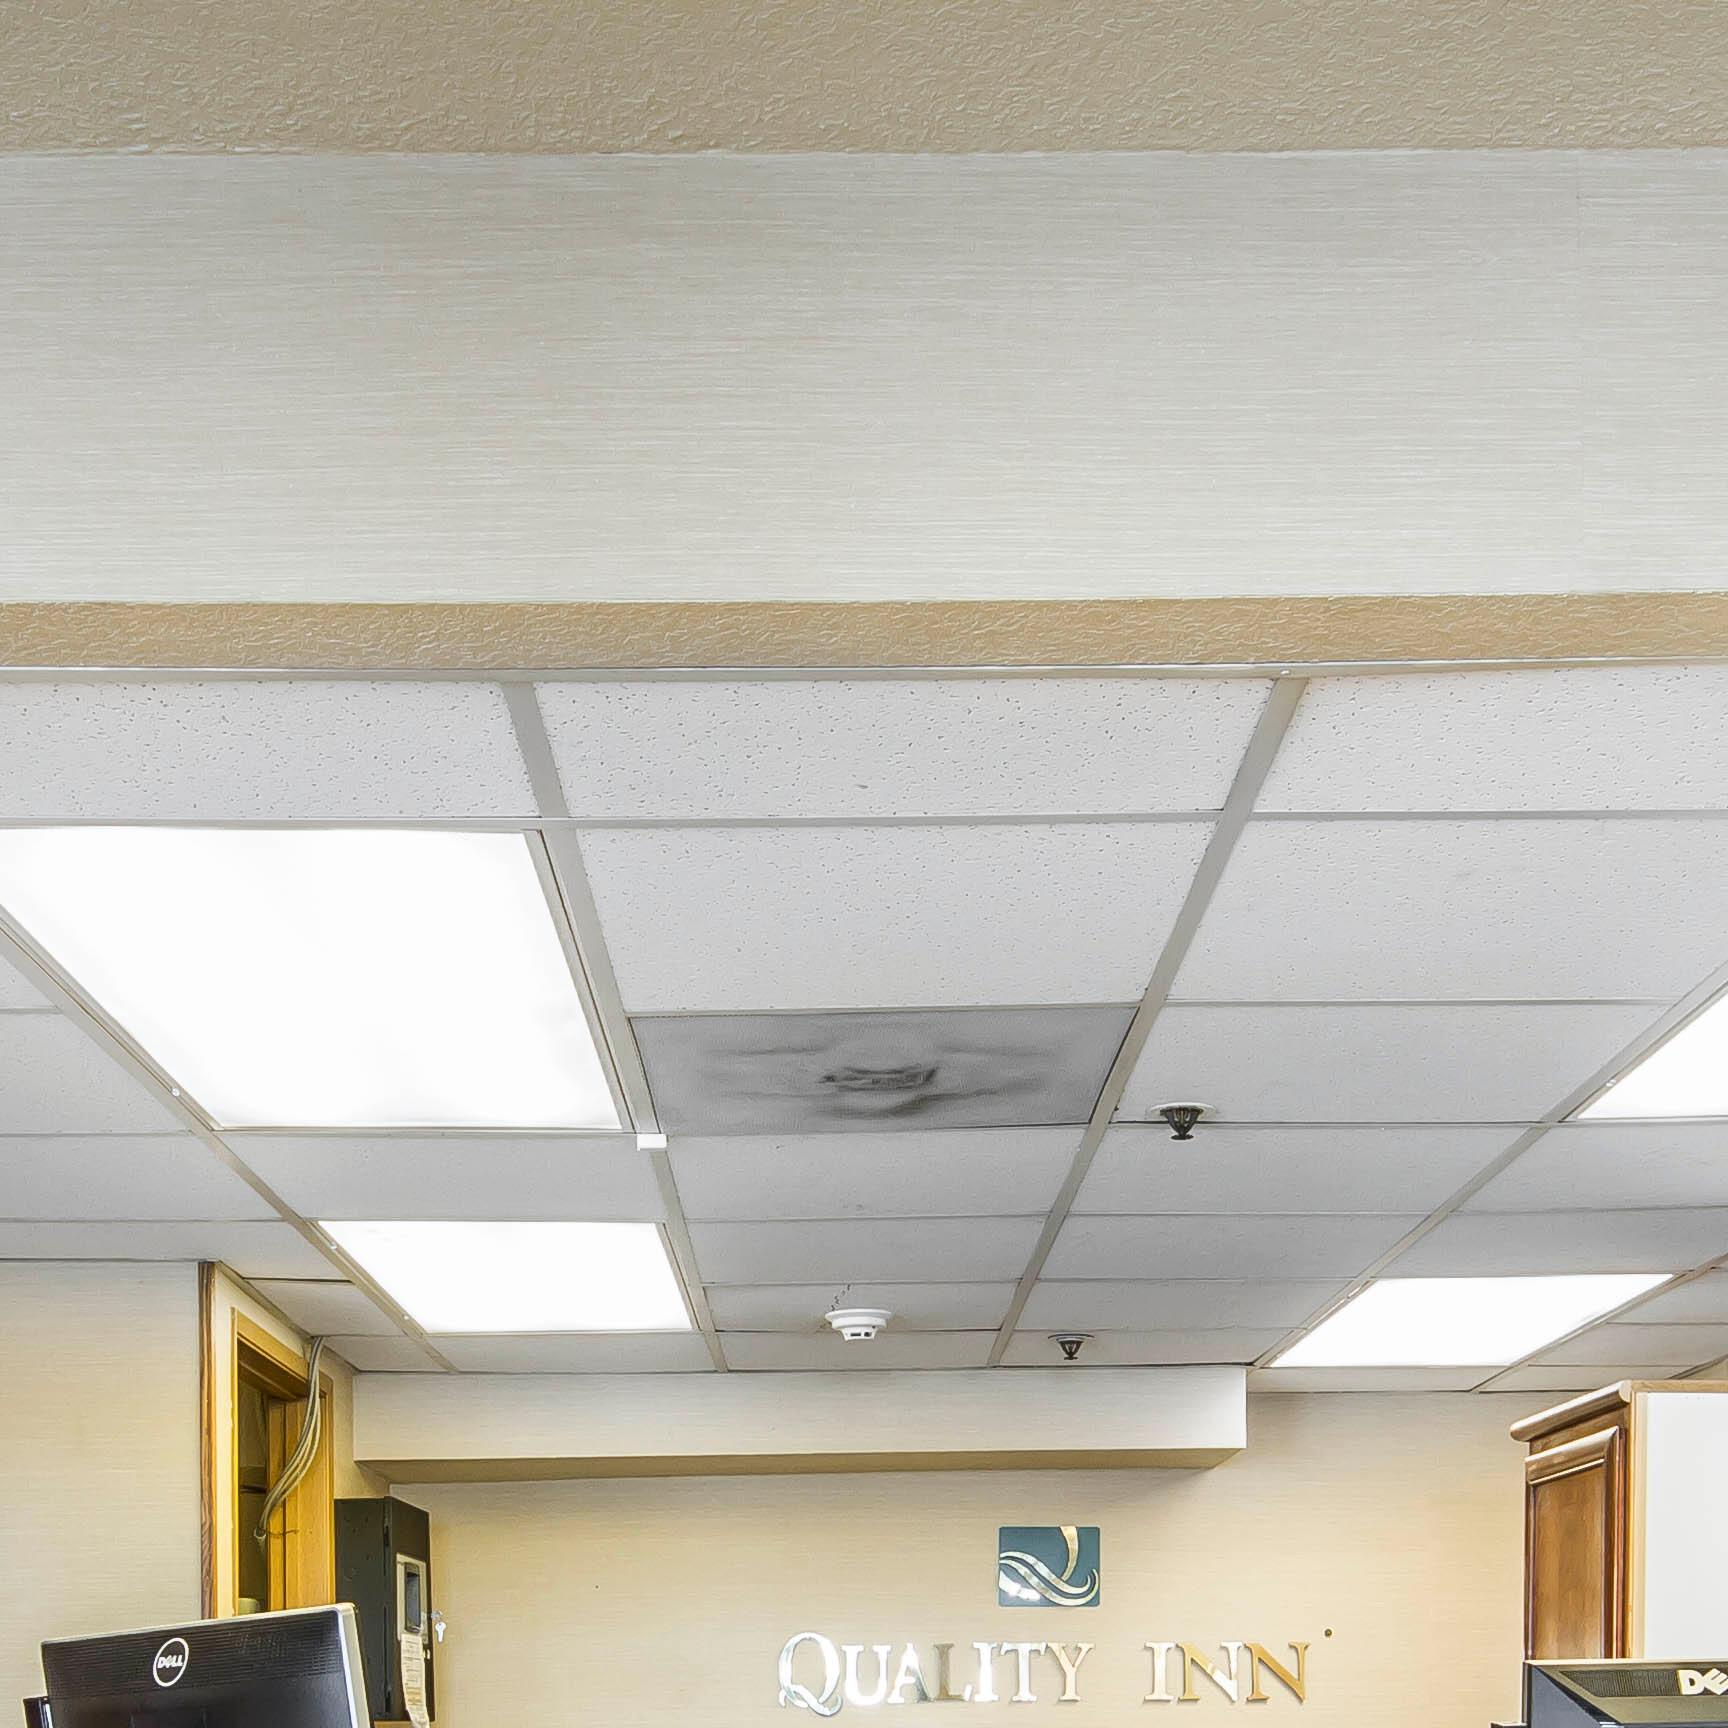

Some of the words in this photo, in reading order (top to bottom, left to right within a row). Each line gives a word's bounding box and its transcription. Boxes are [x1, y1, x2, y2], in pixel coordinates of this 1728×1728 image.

[157, 1655, 184, 1669] DELL
[778, 1631, 1096, 1717] QUALITY
[1144, 1640, 1312, 1704] INN
